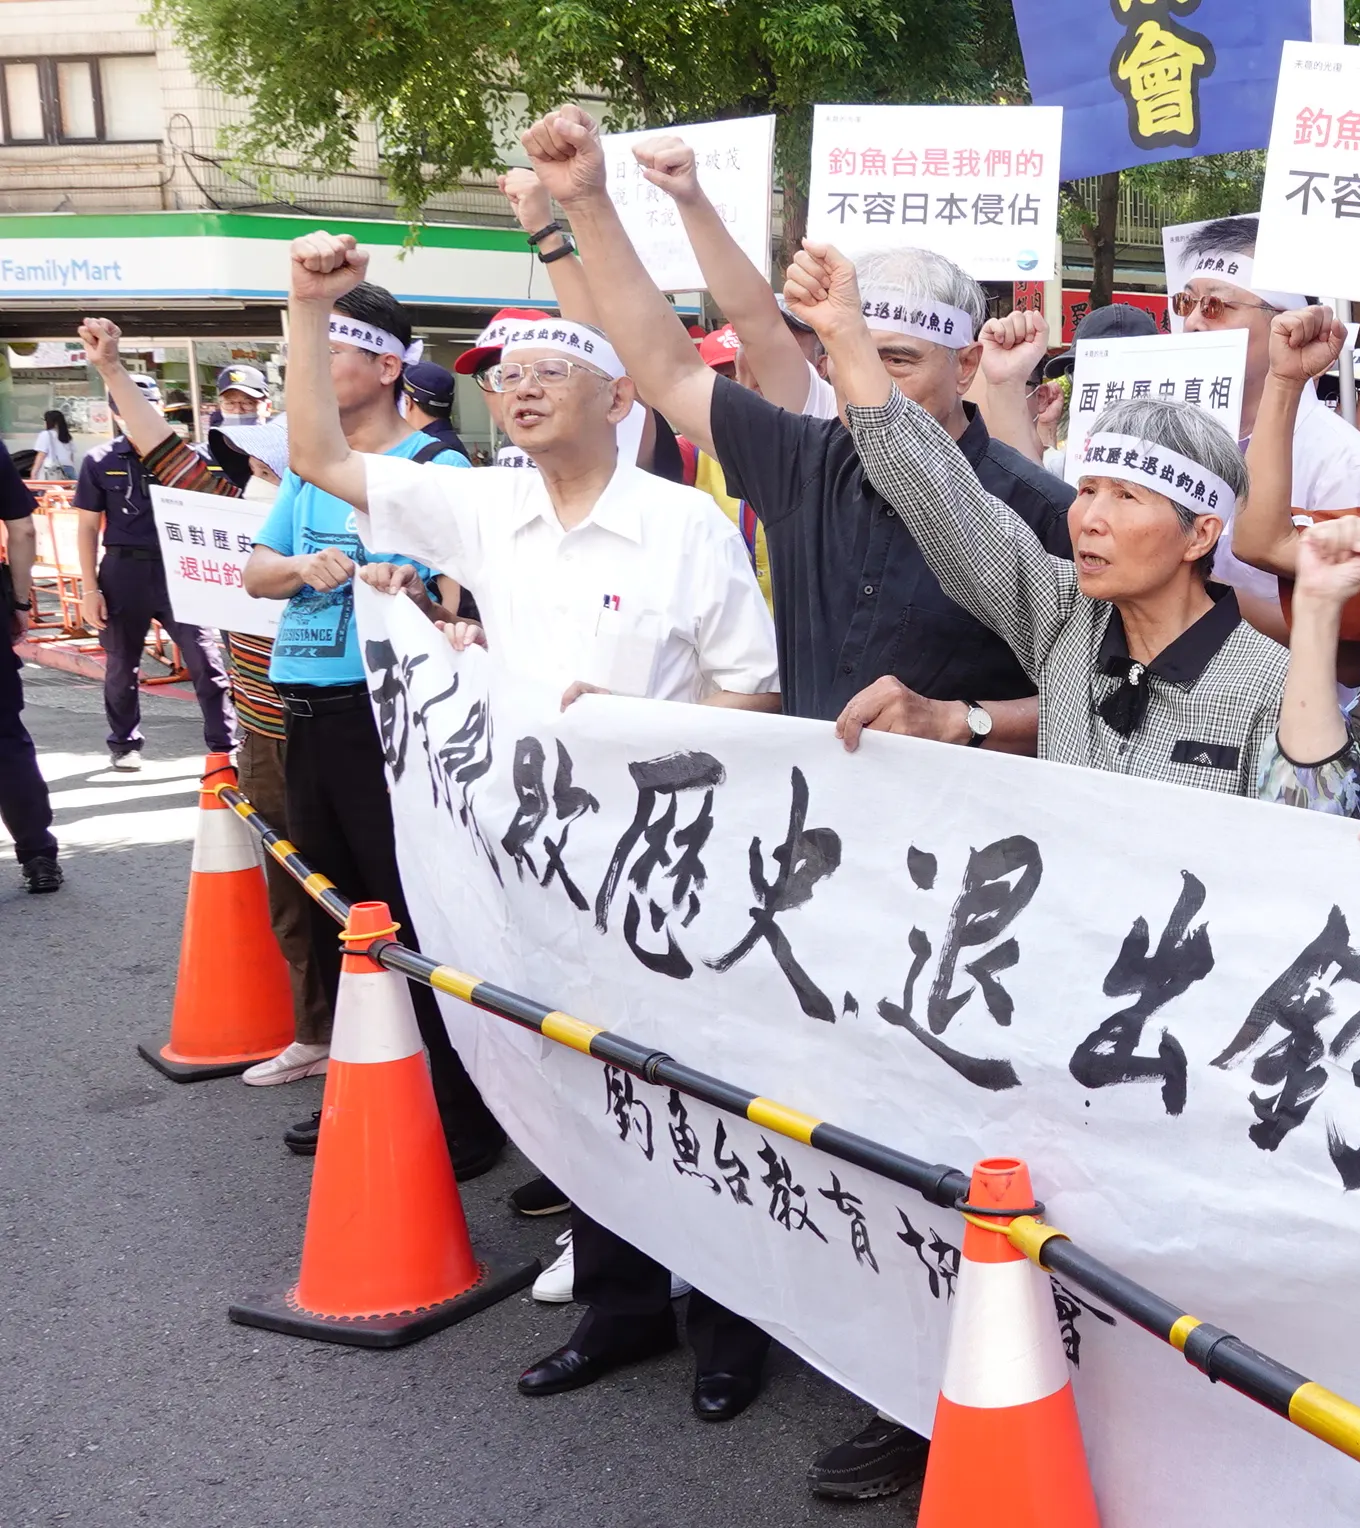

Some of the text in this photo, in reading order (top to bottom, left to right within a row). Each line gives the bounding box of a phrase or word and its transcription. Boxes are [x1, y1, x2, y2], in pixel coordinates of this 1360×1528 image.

[1118, 0, 1206, 137] 會
[828, 147, 1044, 178] 釣魚台是我們的
[827, 191, 1041, 226] 不容日本侵佔
[1, 259, 122, 286] FamilyMart
[504, 327, 595, 355] 史退出釣魚台
